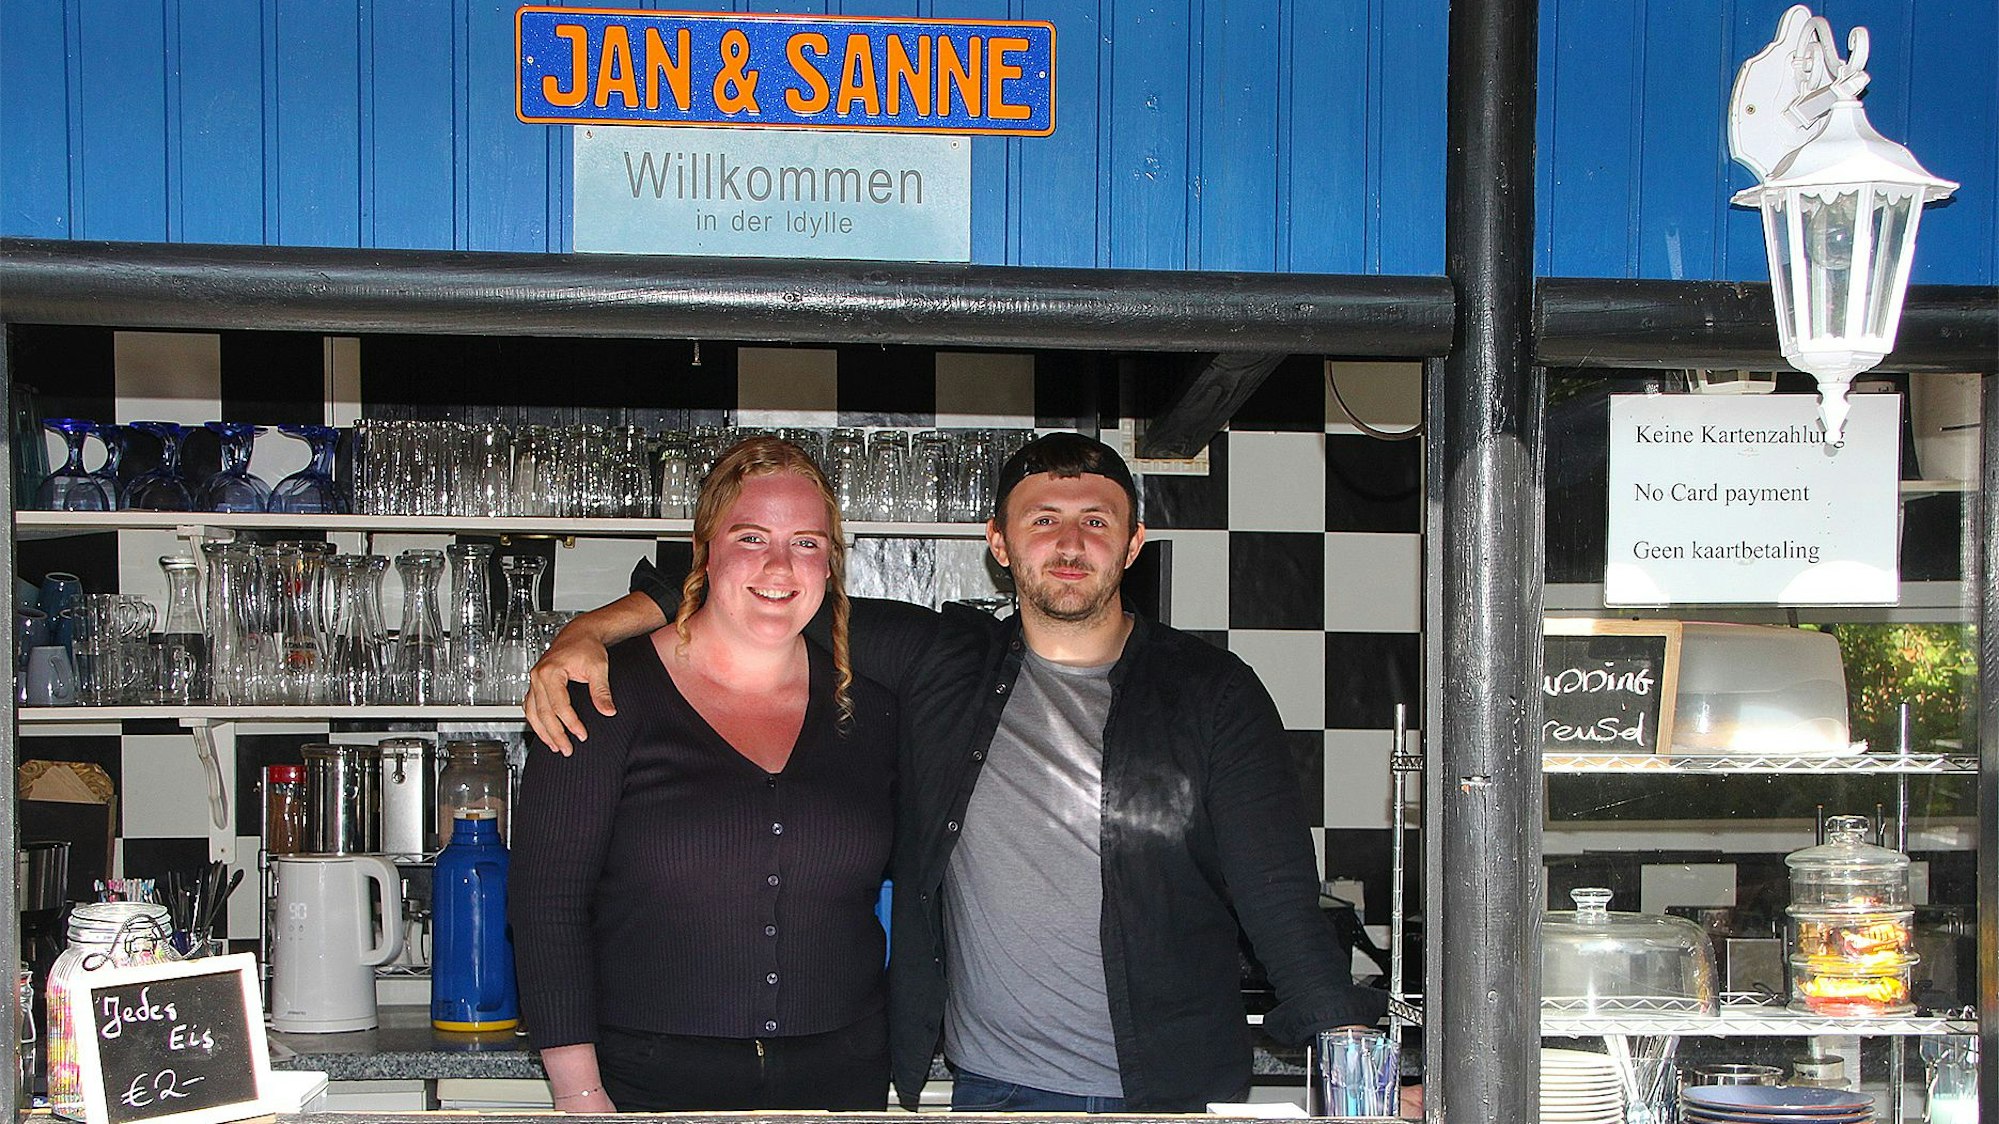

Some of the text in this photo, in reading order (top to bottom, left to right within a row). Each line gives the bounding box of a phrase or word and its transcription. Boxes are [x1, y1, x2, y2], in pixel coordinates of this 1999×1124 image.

[542, 24, 1032, 120] JAN & SANNE
[624, 151, 924, 204] Willkommen
[696, 209, 853, 234] in der Idylle
[1635, 424, 1694, 444] Keine
[1634, 483, 1810, 506] No Card payment
[1633, 541, 1821, 564] Geen kaartbetaling
[169, 1024, 215, 1051] Eis
